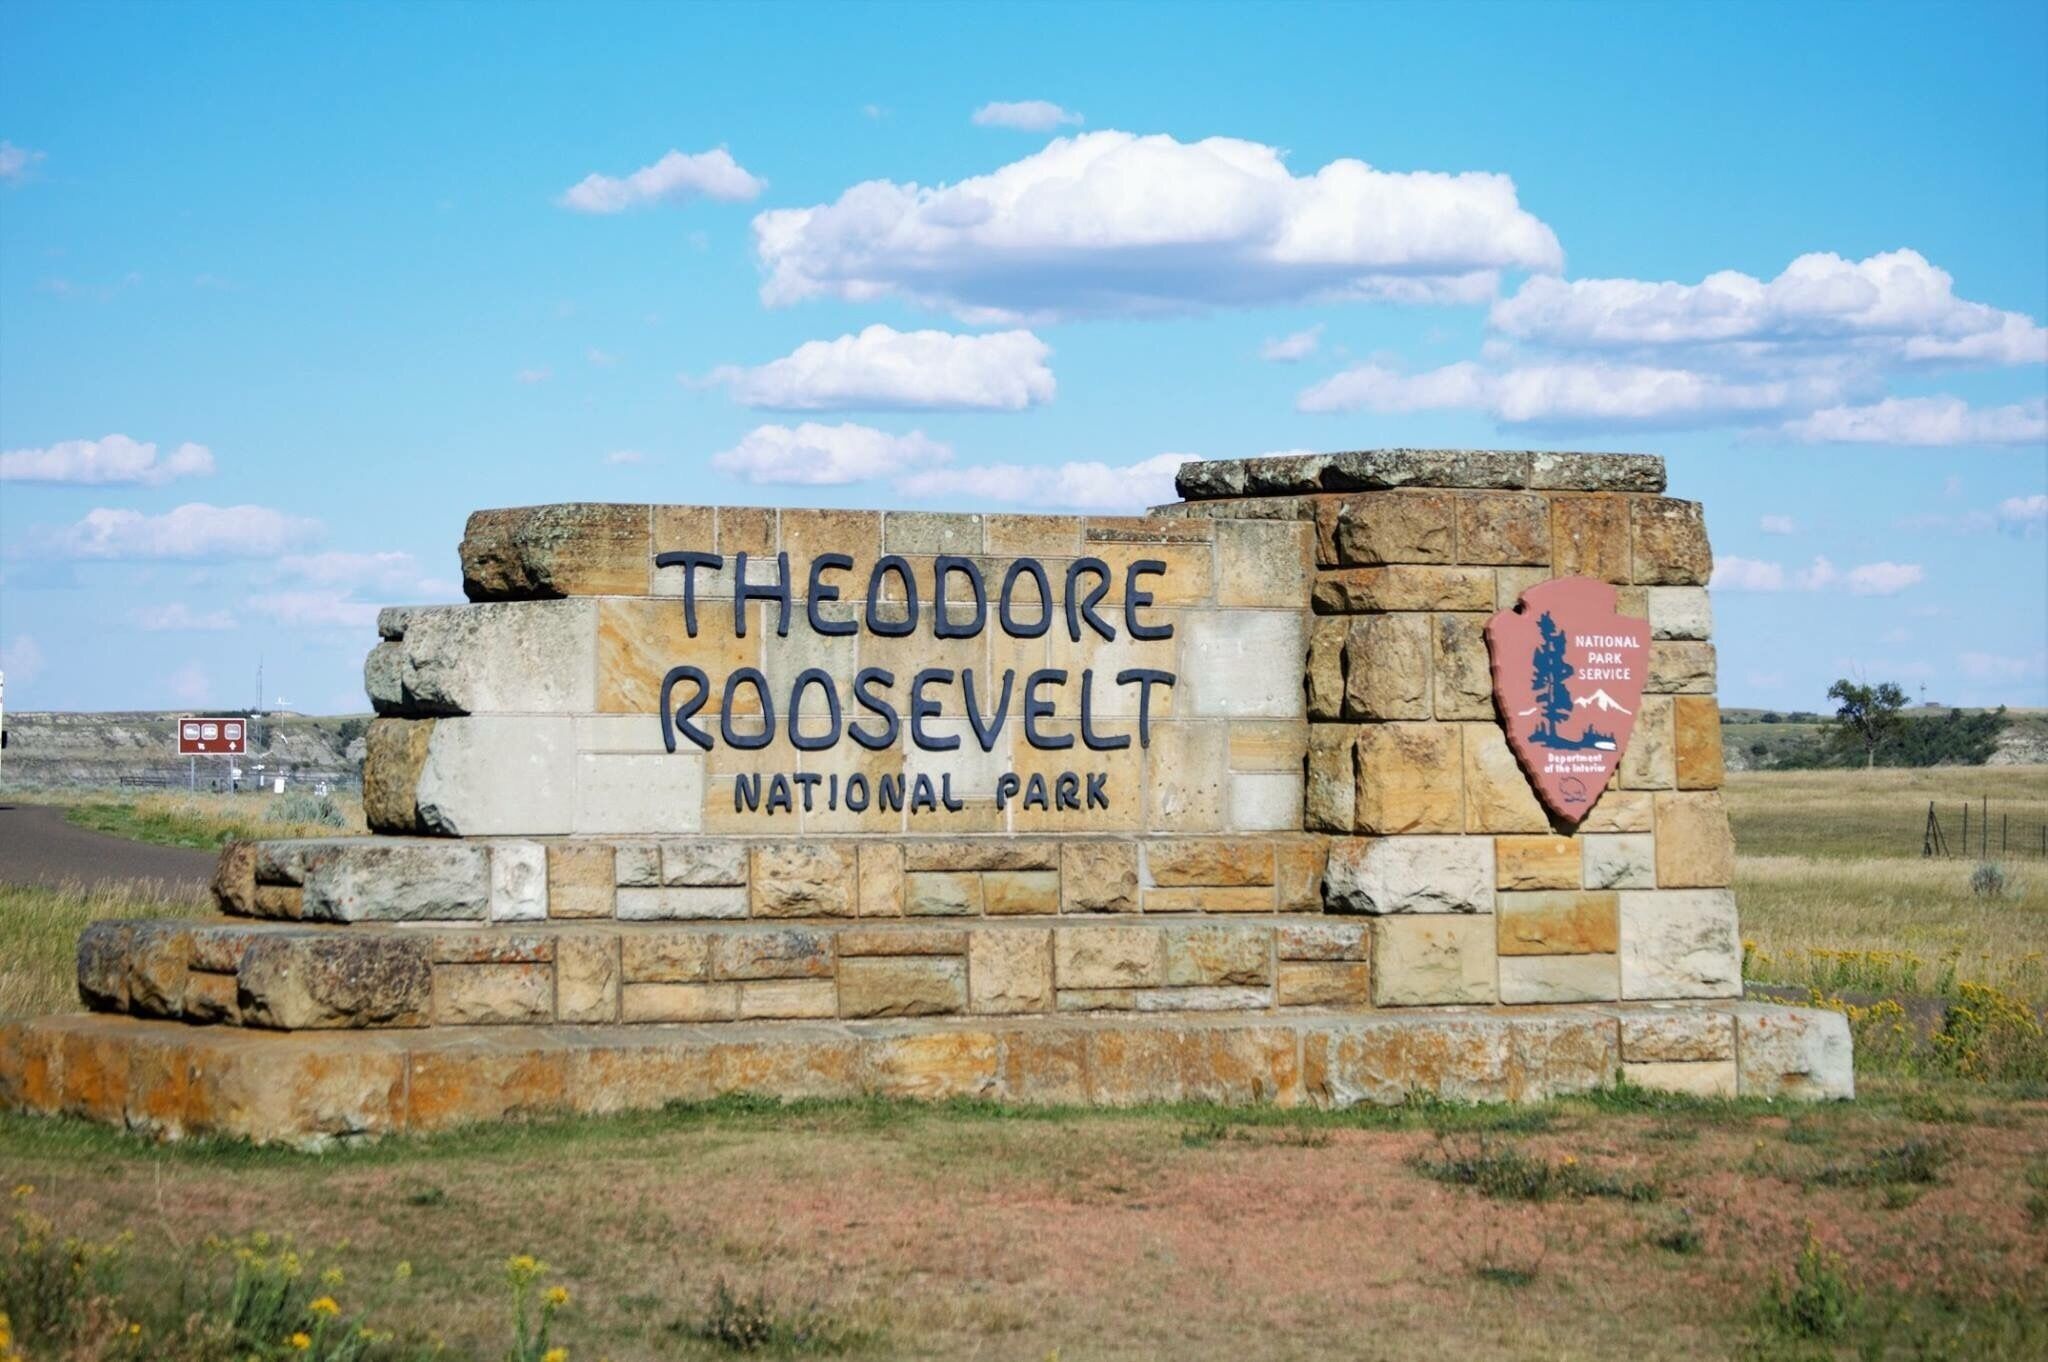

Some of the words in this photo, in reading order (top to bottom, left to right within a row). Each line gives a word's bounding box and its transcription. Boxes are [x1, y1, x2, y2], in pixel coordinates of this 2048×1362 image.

[655, 551, 1175, 642] THEODORE
[1575, 635, 1641, 648] NATIONAL
[1588, 651, 1623, 664] PARK
[1578, 668, 1631, 680] SERVICE
[659, 665, 1177, 753] ROOSEVELT
[1548, 753, 1602, 764] Department
[1544, 764, 1554, 773] of
[1555, 764, 1570, 773] the
[1572, 763, 1606, 773] Interior
[734, 772, 964, 815] NATIONAL
[996, 771, 1110, 811] PARK
